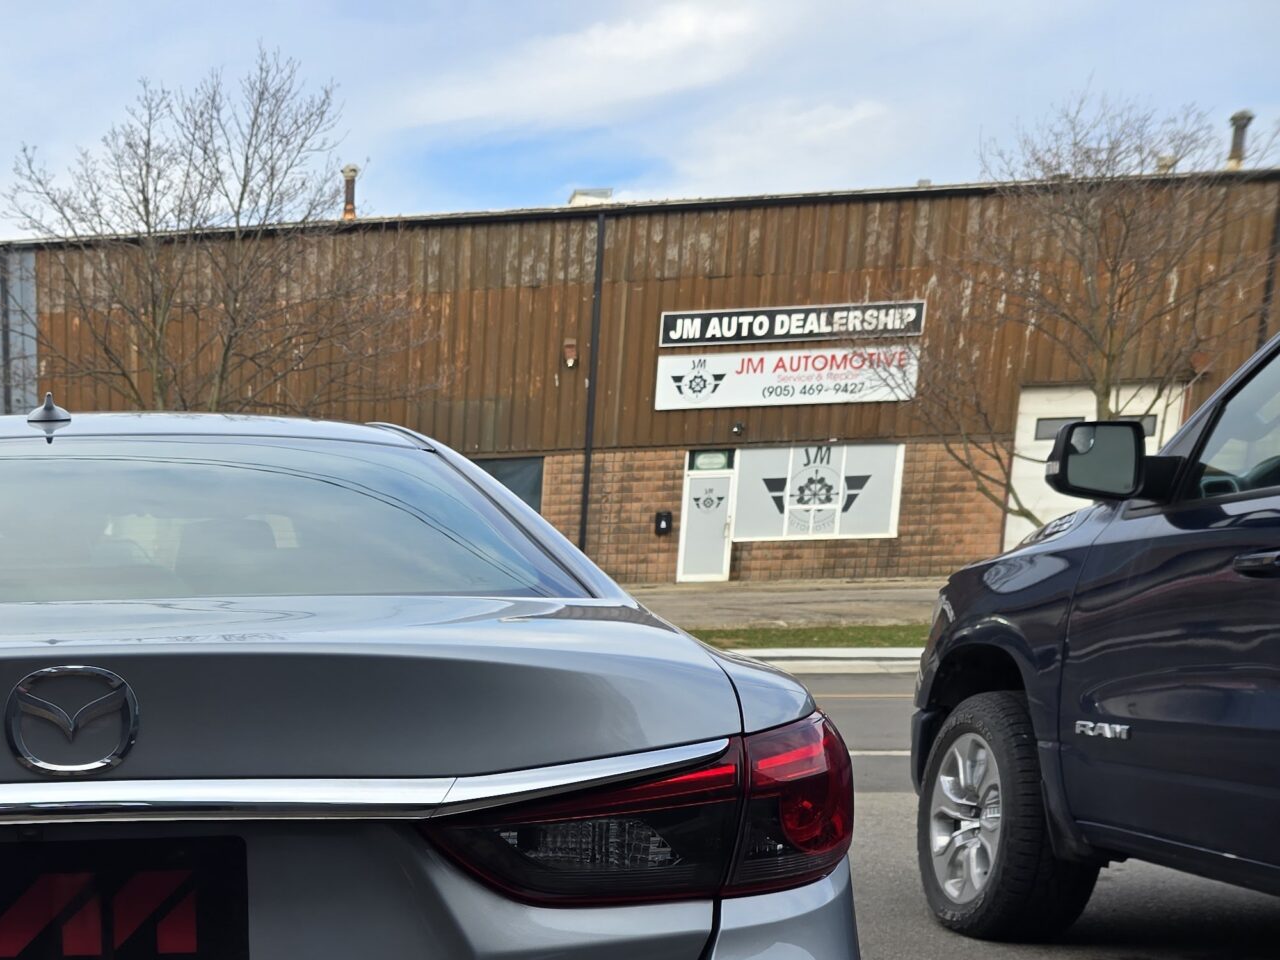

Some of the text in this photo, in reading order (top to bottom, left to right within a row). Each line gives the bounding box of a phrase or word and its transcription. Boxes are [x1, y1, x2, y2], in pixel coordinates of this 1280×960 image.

[669, 307, 917, 340] JM AUTO DEALERSHIP
[735, 350, 907, 375] JM AUTOMOTIVE
[762, 384, 796, 398] (905)
[803, 446, 832, 467] JM
[1074, 719, 1131, 740] RAM
